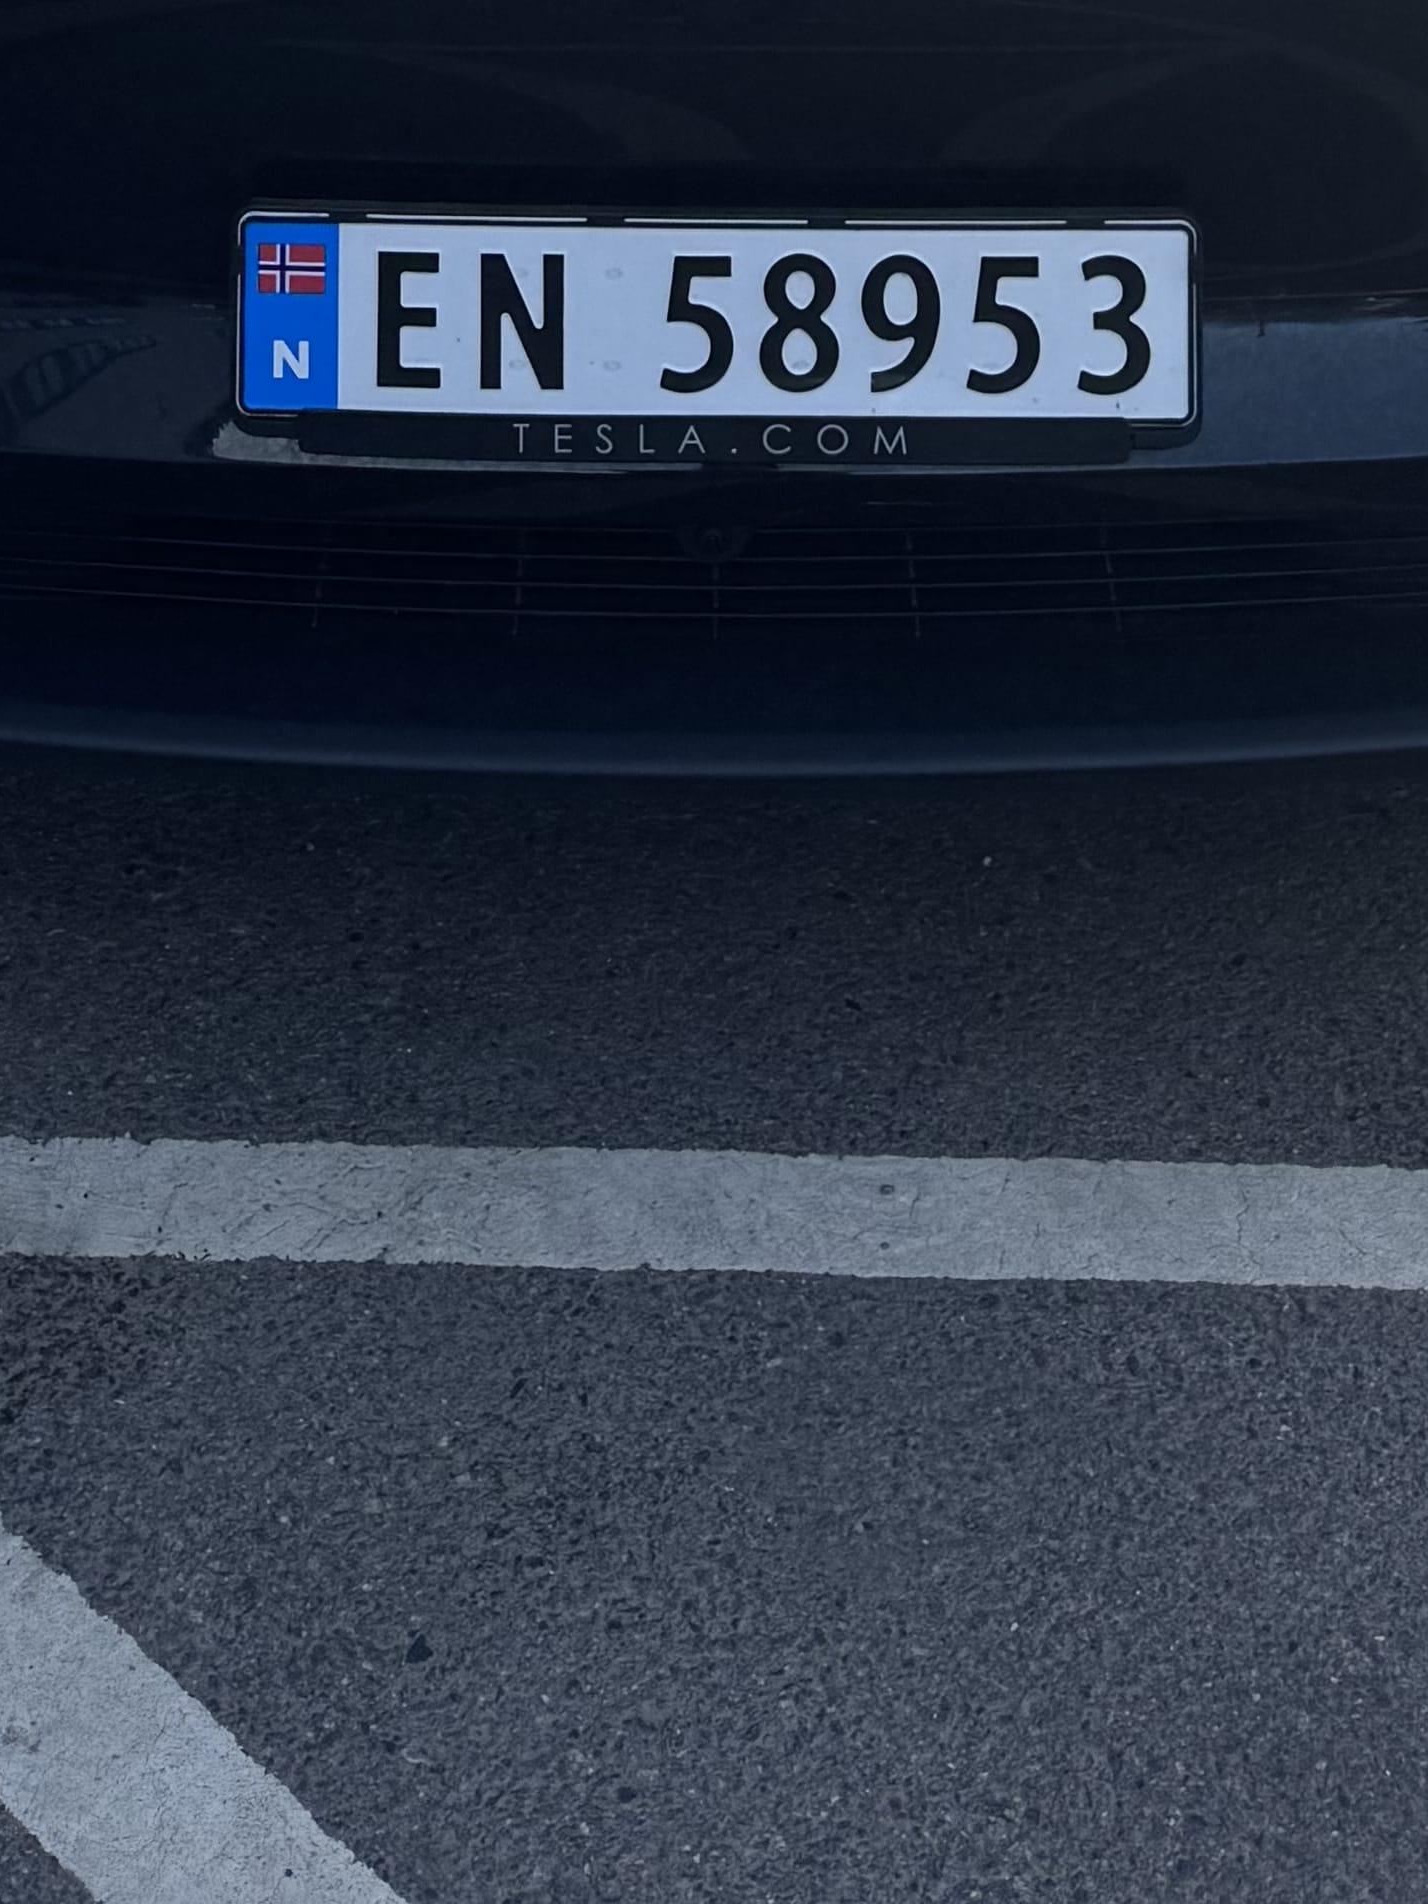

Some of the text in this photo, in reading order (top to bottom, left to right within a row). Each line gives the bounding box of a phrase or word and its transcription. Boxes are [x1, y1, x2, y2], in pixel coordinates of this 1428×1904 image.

[376, 251, 1152, 395] EN 58953
[273, 340, 310, 379] N
[512, 423, 908, 455] TESLA.COM
